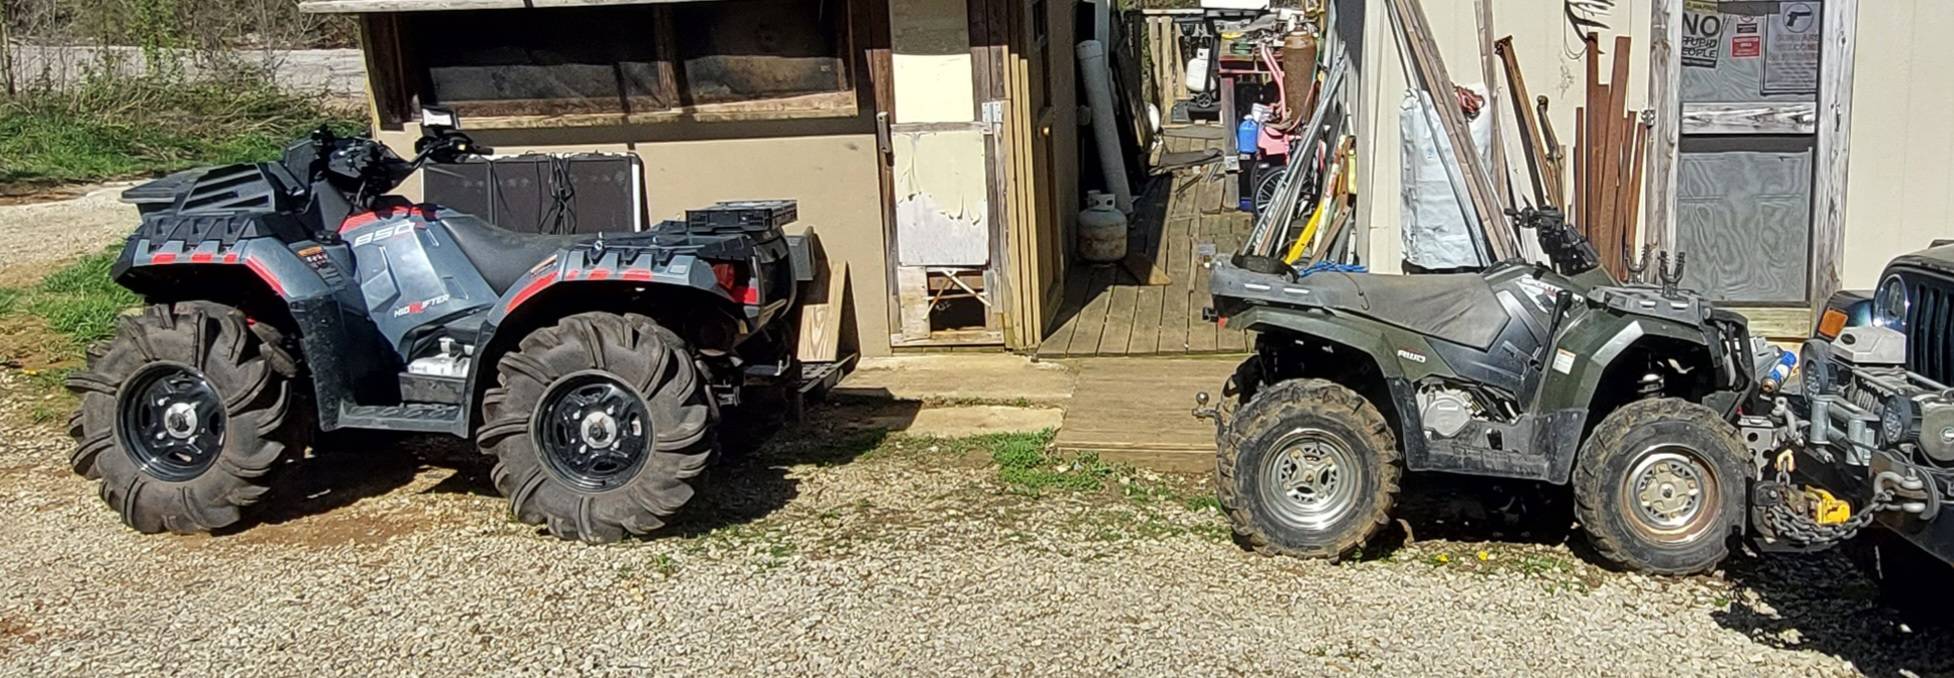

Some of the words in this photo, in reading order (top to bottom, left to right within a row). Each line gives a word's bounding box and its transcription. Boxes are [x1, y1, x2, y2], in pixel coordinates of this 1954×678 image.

[1682, 12, 1721, 37] NO
[1682, 35, 1718, 49] TUPID
[1681, 46, 1718, 58] EOPLE
[354, 221, 416, 248] 850
